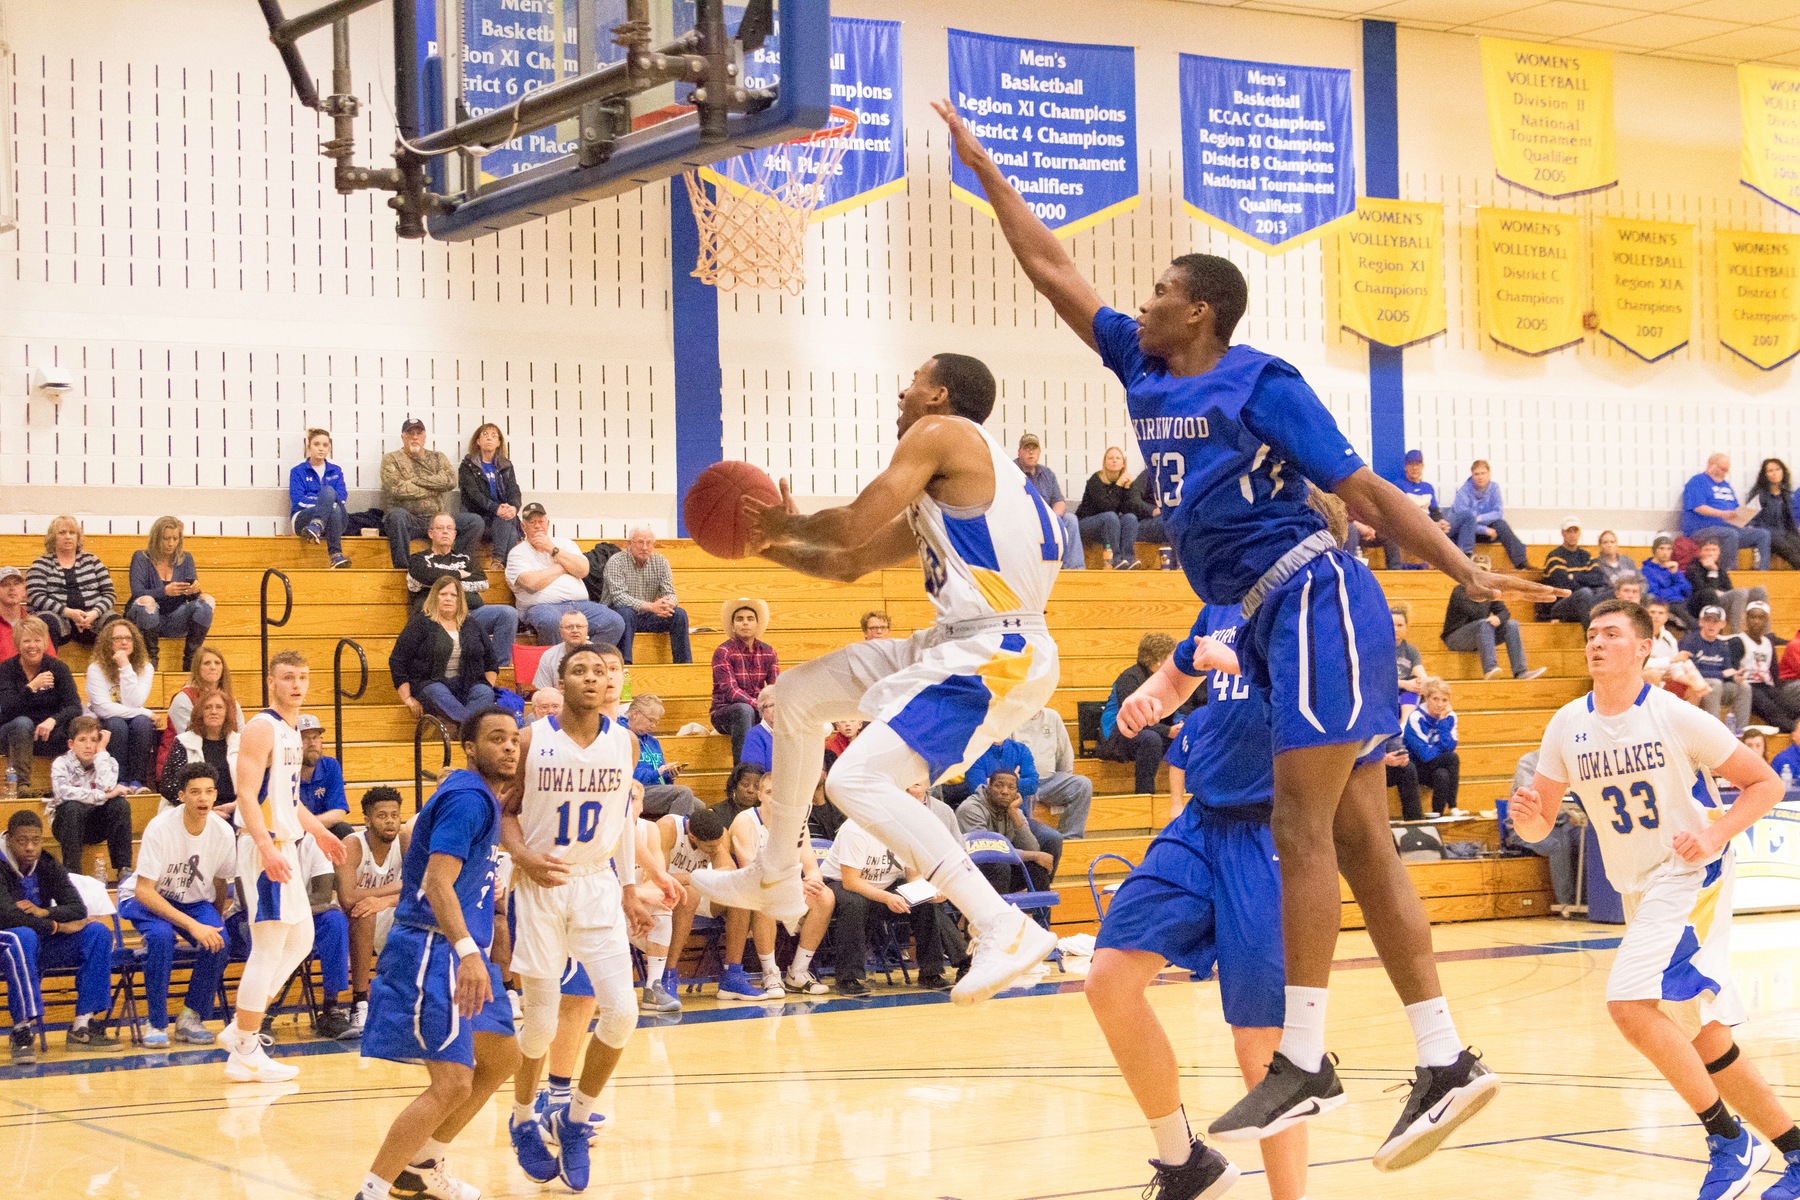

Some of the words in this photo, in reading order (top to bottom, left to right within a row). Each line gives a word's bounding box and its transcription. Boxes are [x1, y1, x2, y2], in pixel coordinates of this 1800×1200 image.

[481, 19, 577, 45] Basketbll
[500, 49, 520, 67] XI
[1019, 49, 1066, 68] Men's
[1514, 52, 1581, 71] WOMEN'S
[505, 77, 518, 95] 6
[1001, 73, 1083, 95] Basketball
[1247, 70, 1286, 87] Men's
[1507, 71, 1589, 91] VOLLEYBALL
[830, 80, 893, 101] mpions
[1233, 90, 1300, 108] Basketball
[958, 91, 1013, 116] Region
[1018, 100, 1034, 116] XI
[1039, 102, 1126, 124] Champions
[1513, 92, 1568, 111] Division
[1209, 108, 1251, 126] ICCAC
[1254, 113, 1325, 133] Champions
[1521, 114, 1580, 131] National
[962, 117, 1018, 141] District
[1022, 126, 1033, 141] 4
[1037, 127, 1125, 149] Champions
[1200, 129, 1245, 148] Region
[1248, 134, 1261, 148] XI
[1265, 135, 1335, 155] Champions
[1510, 129, 1592, 148] Tournament
[529, 135, 579, 154] Place
[1032, 152, 1126, 172] Tournament
[1202, 150, 1249, 169] District
[1250, 155, 1260, 170] 8
[1264, 156, 1334, 175] Champions
[1523, 148, 1578, 165] Qualifier
[797, 156, 843, 176] Place
[1203, 172, 1256, 191] National
[1260, 177, 1335, 194] Tournament
[1533, 168, 1567, 183] 2005
[1006, 175, 1083, 196] Qualifiers
[1239, 197, 1302, 214] Qualifiers
[1357, 208, 1423, 226] WOMEN'S
[1255, 219, 1287, 235] 2013
[1500, 219, 1561, 237] WOMEN'S
[1349, 231, 1432, 249] VOLLEYBALL
[1618, 229, 1677, 246] WOMEN'S
[1492, 240, 1568, 260] VOLLEYBALL
[1733, 242, 1790, 256] WOMEN'S
[1358, 257, 1404, 274] Region
[1410, 260, 1425, 273] XI
[1612, 251, 1684, 270] VOLLEYBALL
[1503, 266, 1546, 281] District
[1551, 269, 1560, 282] C
[1728, 264, 1798, 279] VOLLEYBALL
[1354, 280, 1428, 298] Champions
[1615, 274, 1654, 291] Region
[1496, 288, 1565, 306] Champions
[1737, 285, 1777, 299] District
[1377, 308, 1410, 323] 2005
[1617, 298, 1682, 315] Champions
[1516, 316, 1548, 331] 2005
[1733, 308, 1797, 324] Champions
[1636, 325, 1663, 338] 2007
[1131, 416, 1210, 441] KIRKWOOD
[1151, 452, 1185, 508] 13
[1577, 750, 1613, 781] IOWA
[1613, 741, 1665, 776] LAKES
[538, 767, 574, 792] IOWA
[579, 768, 622, 793] LAKES
[1602, 780, 1659, 834] 33
[555, 801, 603, 846] 10
